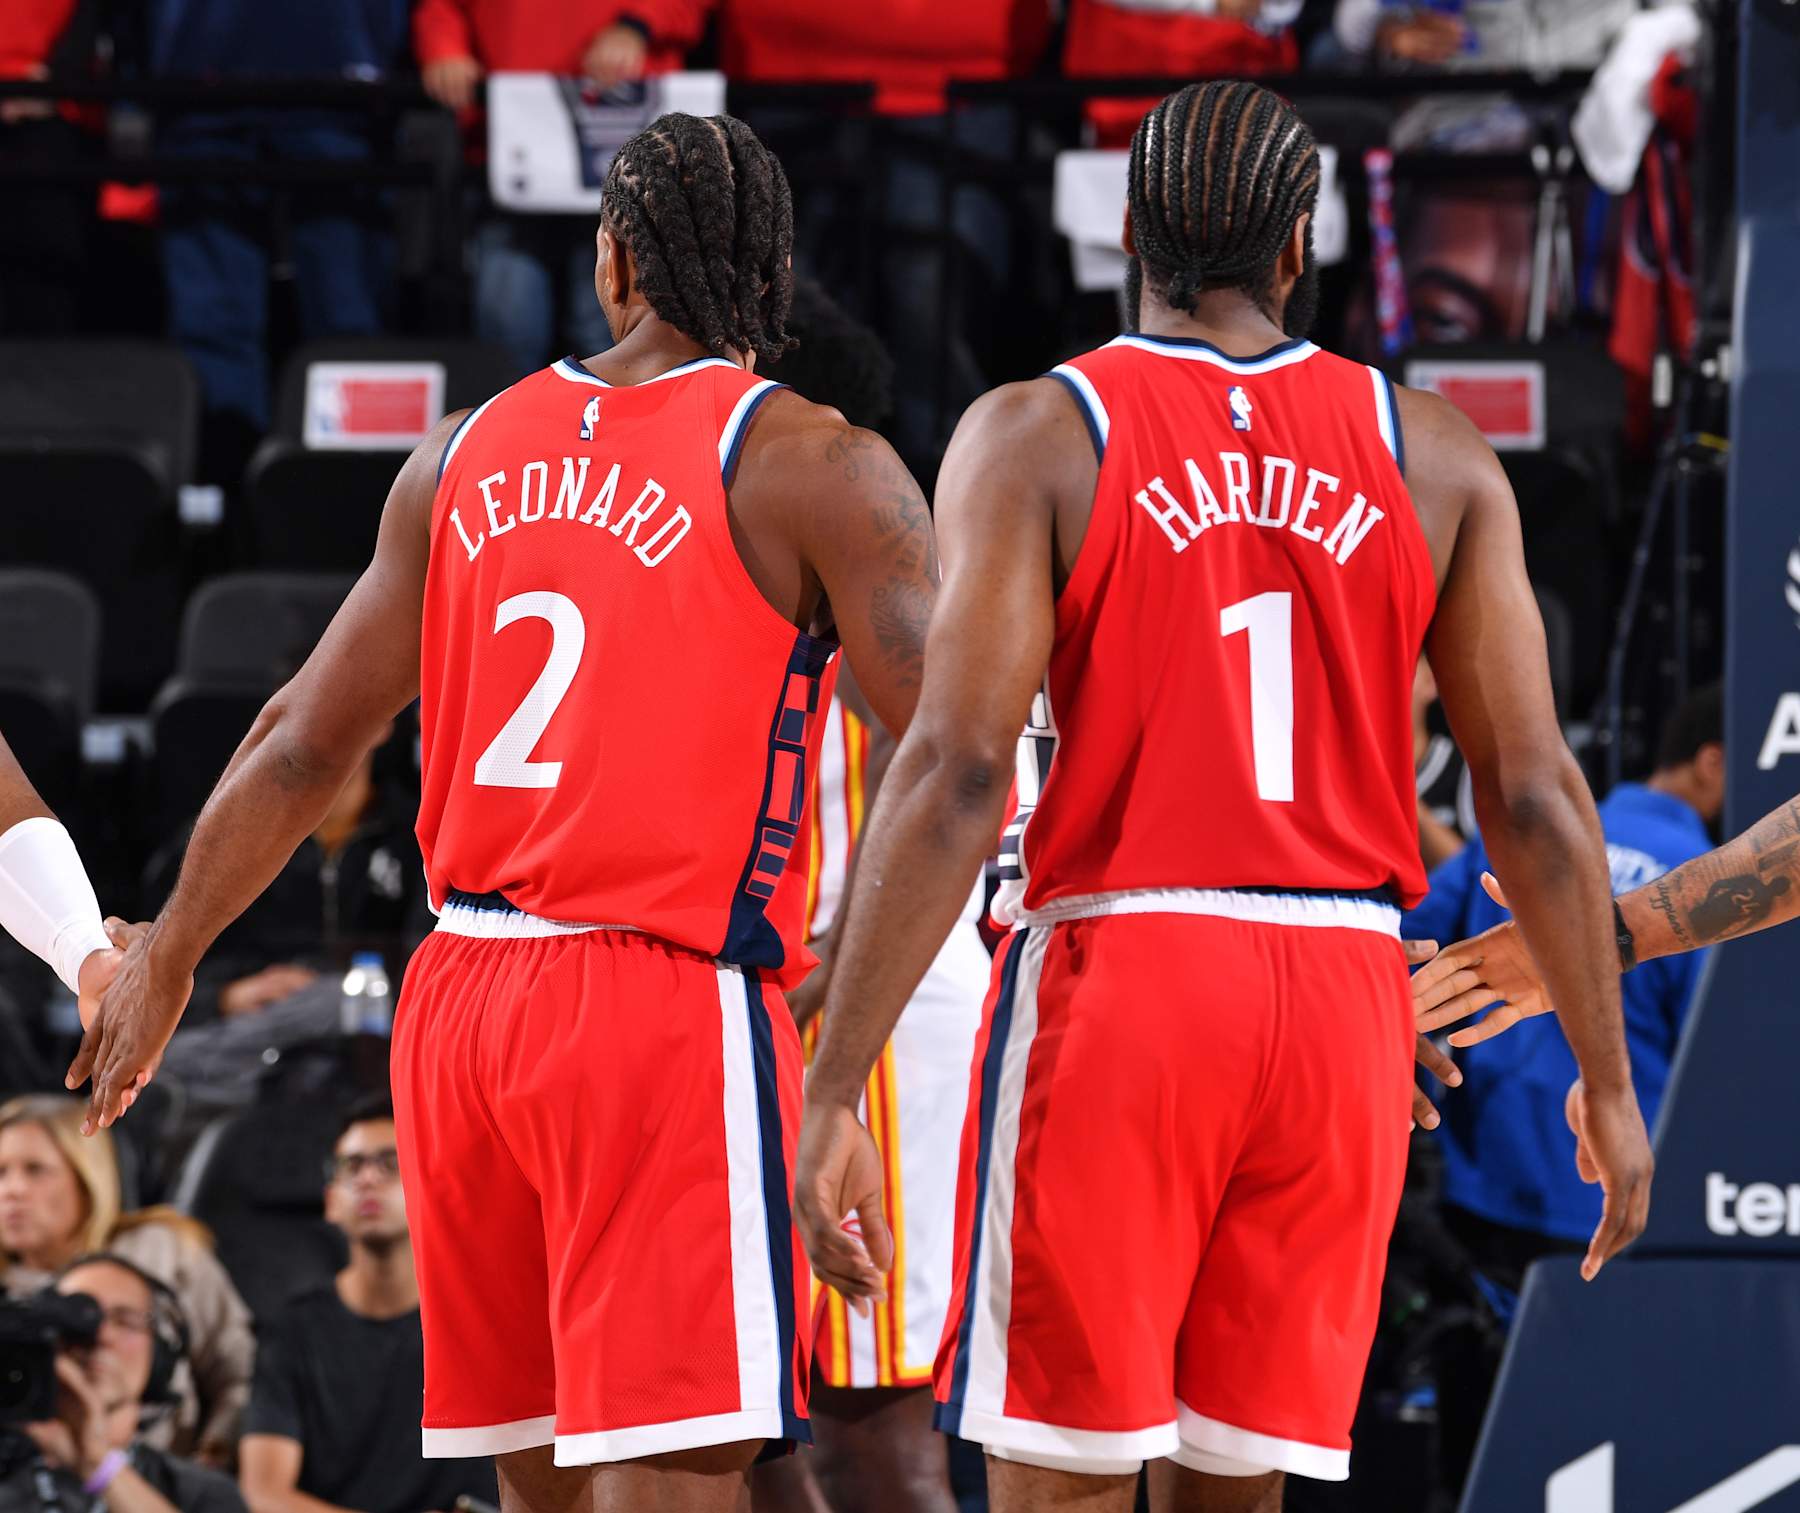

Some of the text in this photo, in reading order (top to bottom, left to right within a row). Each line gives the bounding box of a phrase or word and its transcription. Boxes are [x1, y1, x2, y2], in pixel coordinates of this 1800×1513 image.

[449, 457, 692, 568] LEONARD
[1134, 451, 1385, 566] HARDEN
[474, 590, 586, 788] 2
[1219, 591, 1294, 802] 1
